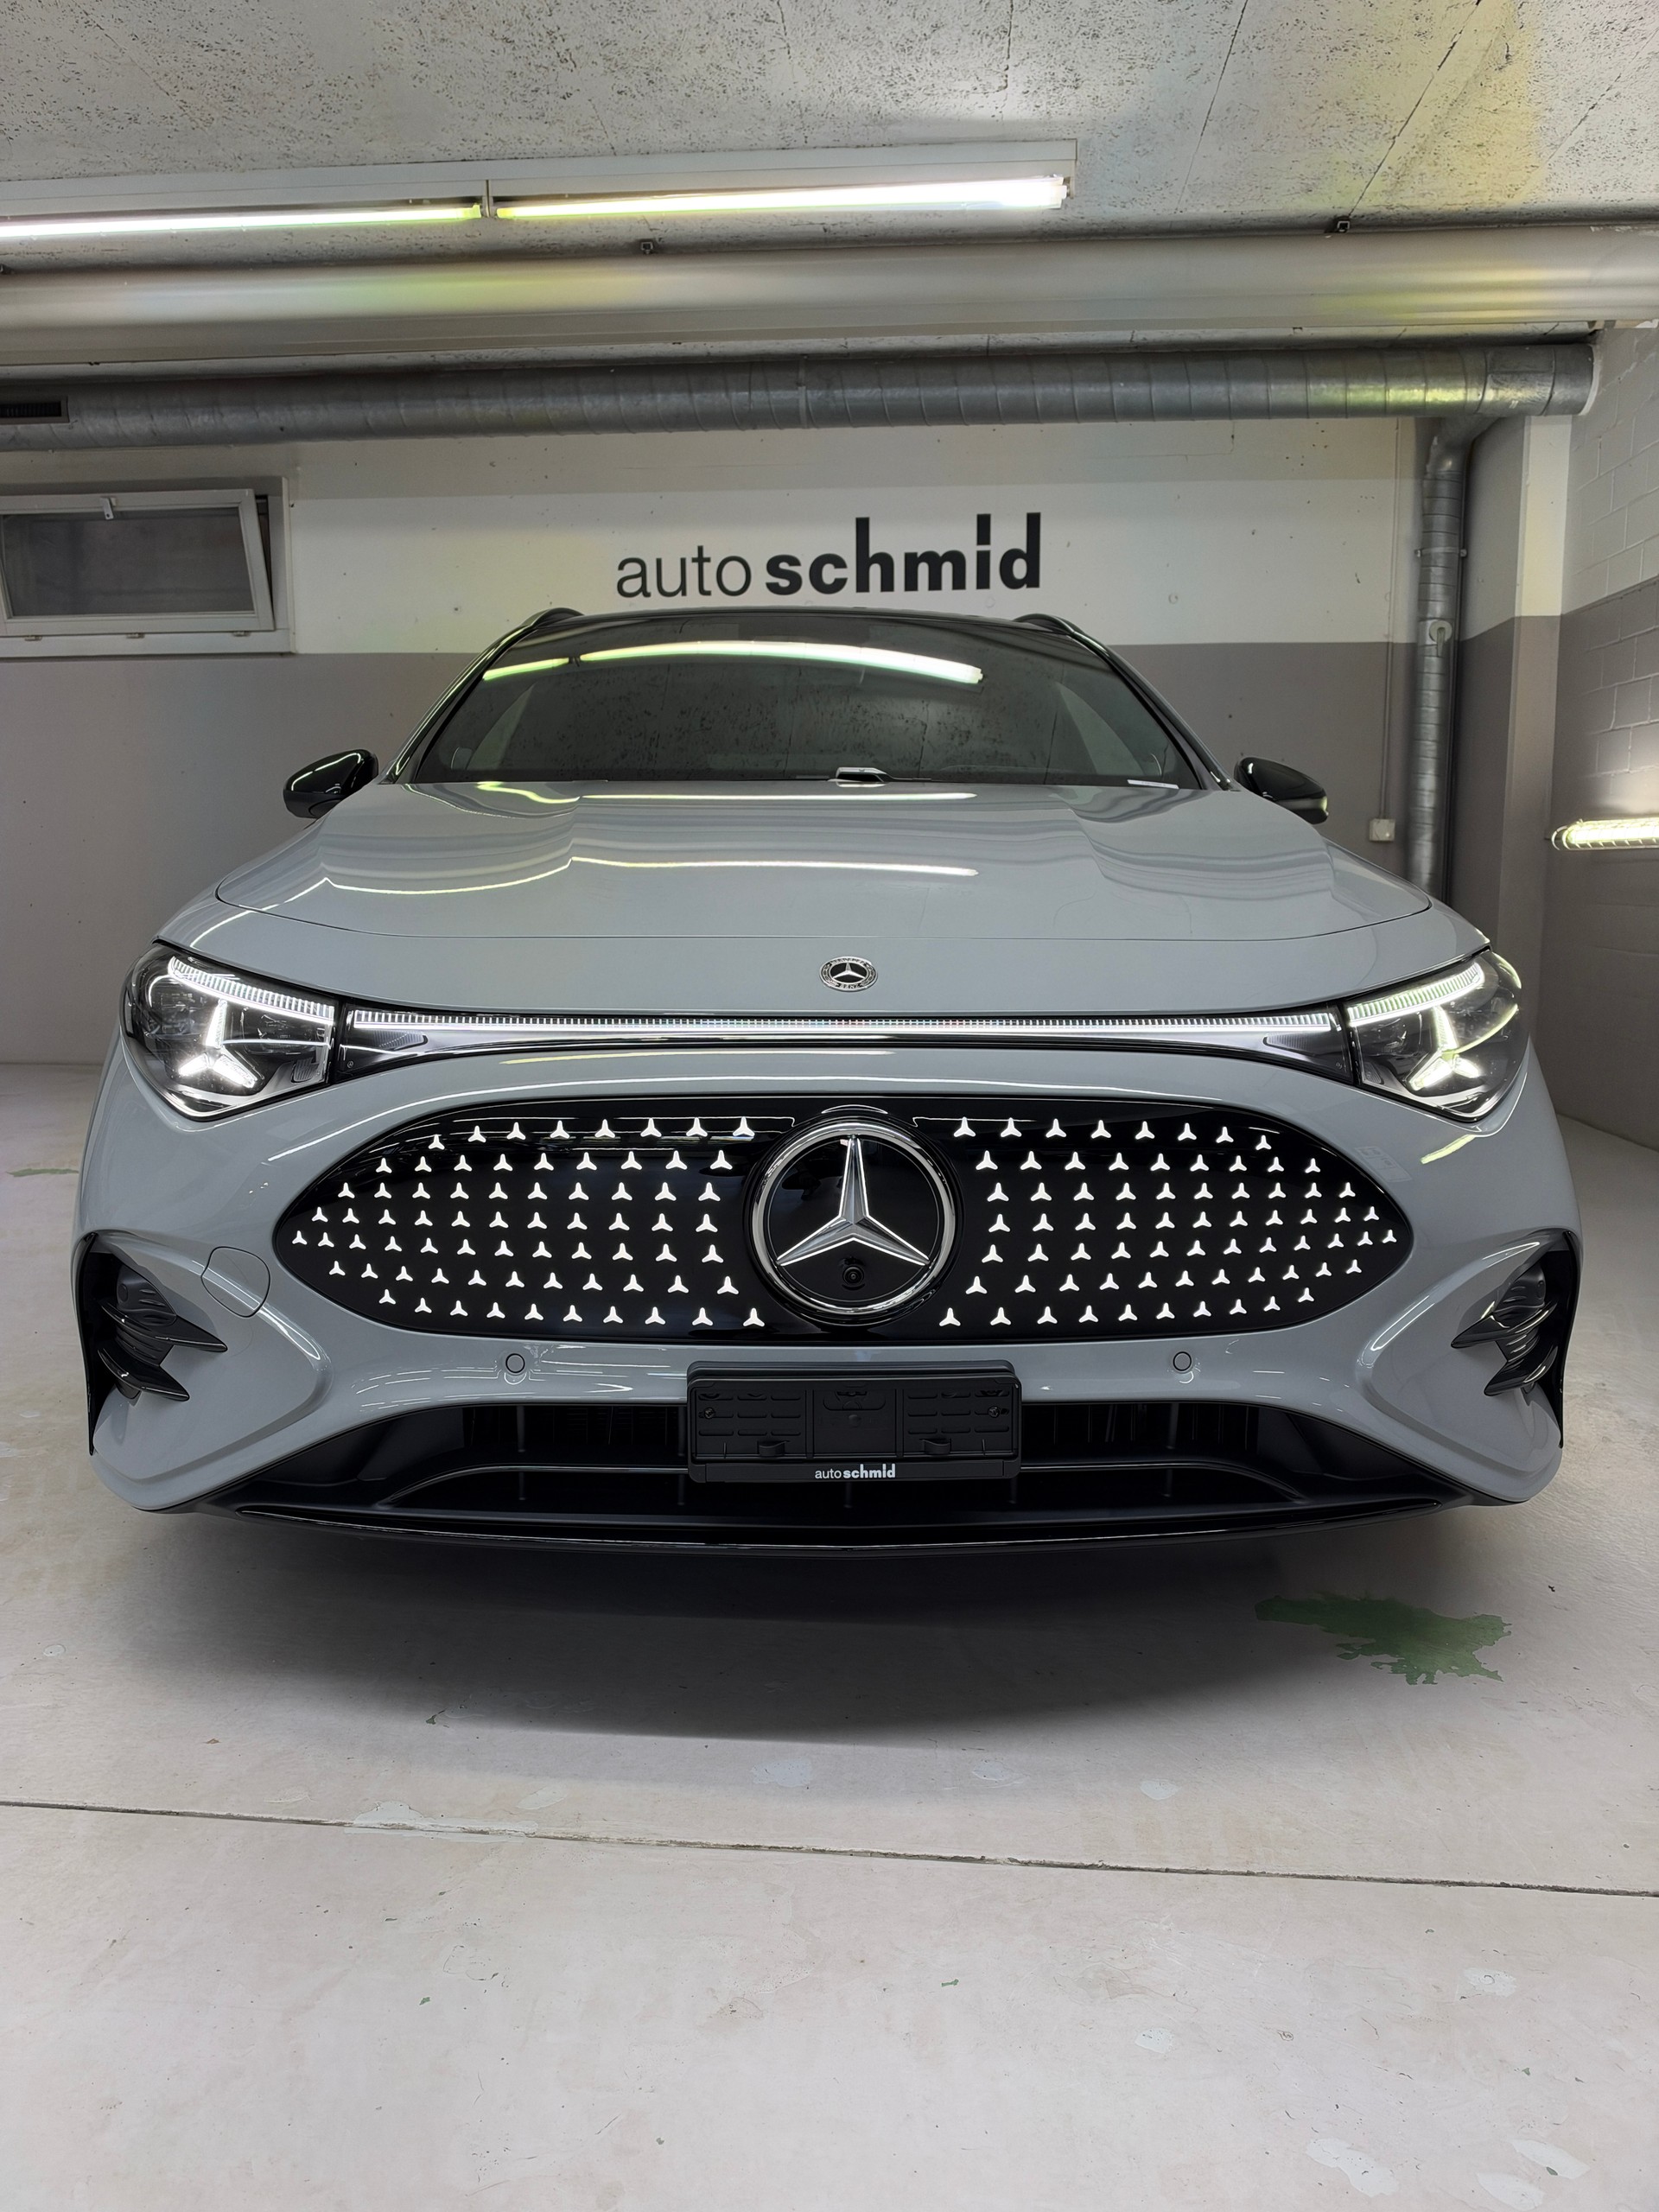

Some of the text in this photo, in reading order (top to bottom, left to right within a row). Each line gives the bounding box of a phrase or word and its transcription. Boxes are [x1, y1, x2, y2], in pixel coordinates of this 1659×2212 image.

[616, 512, 1041, 598] auto schmid
[814, 1463, 896, 1479] auto schmid
